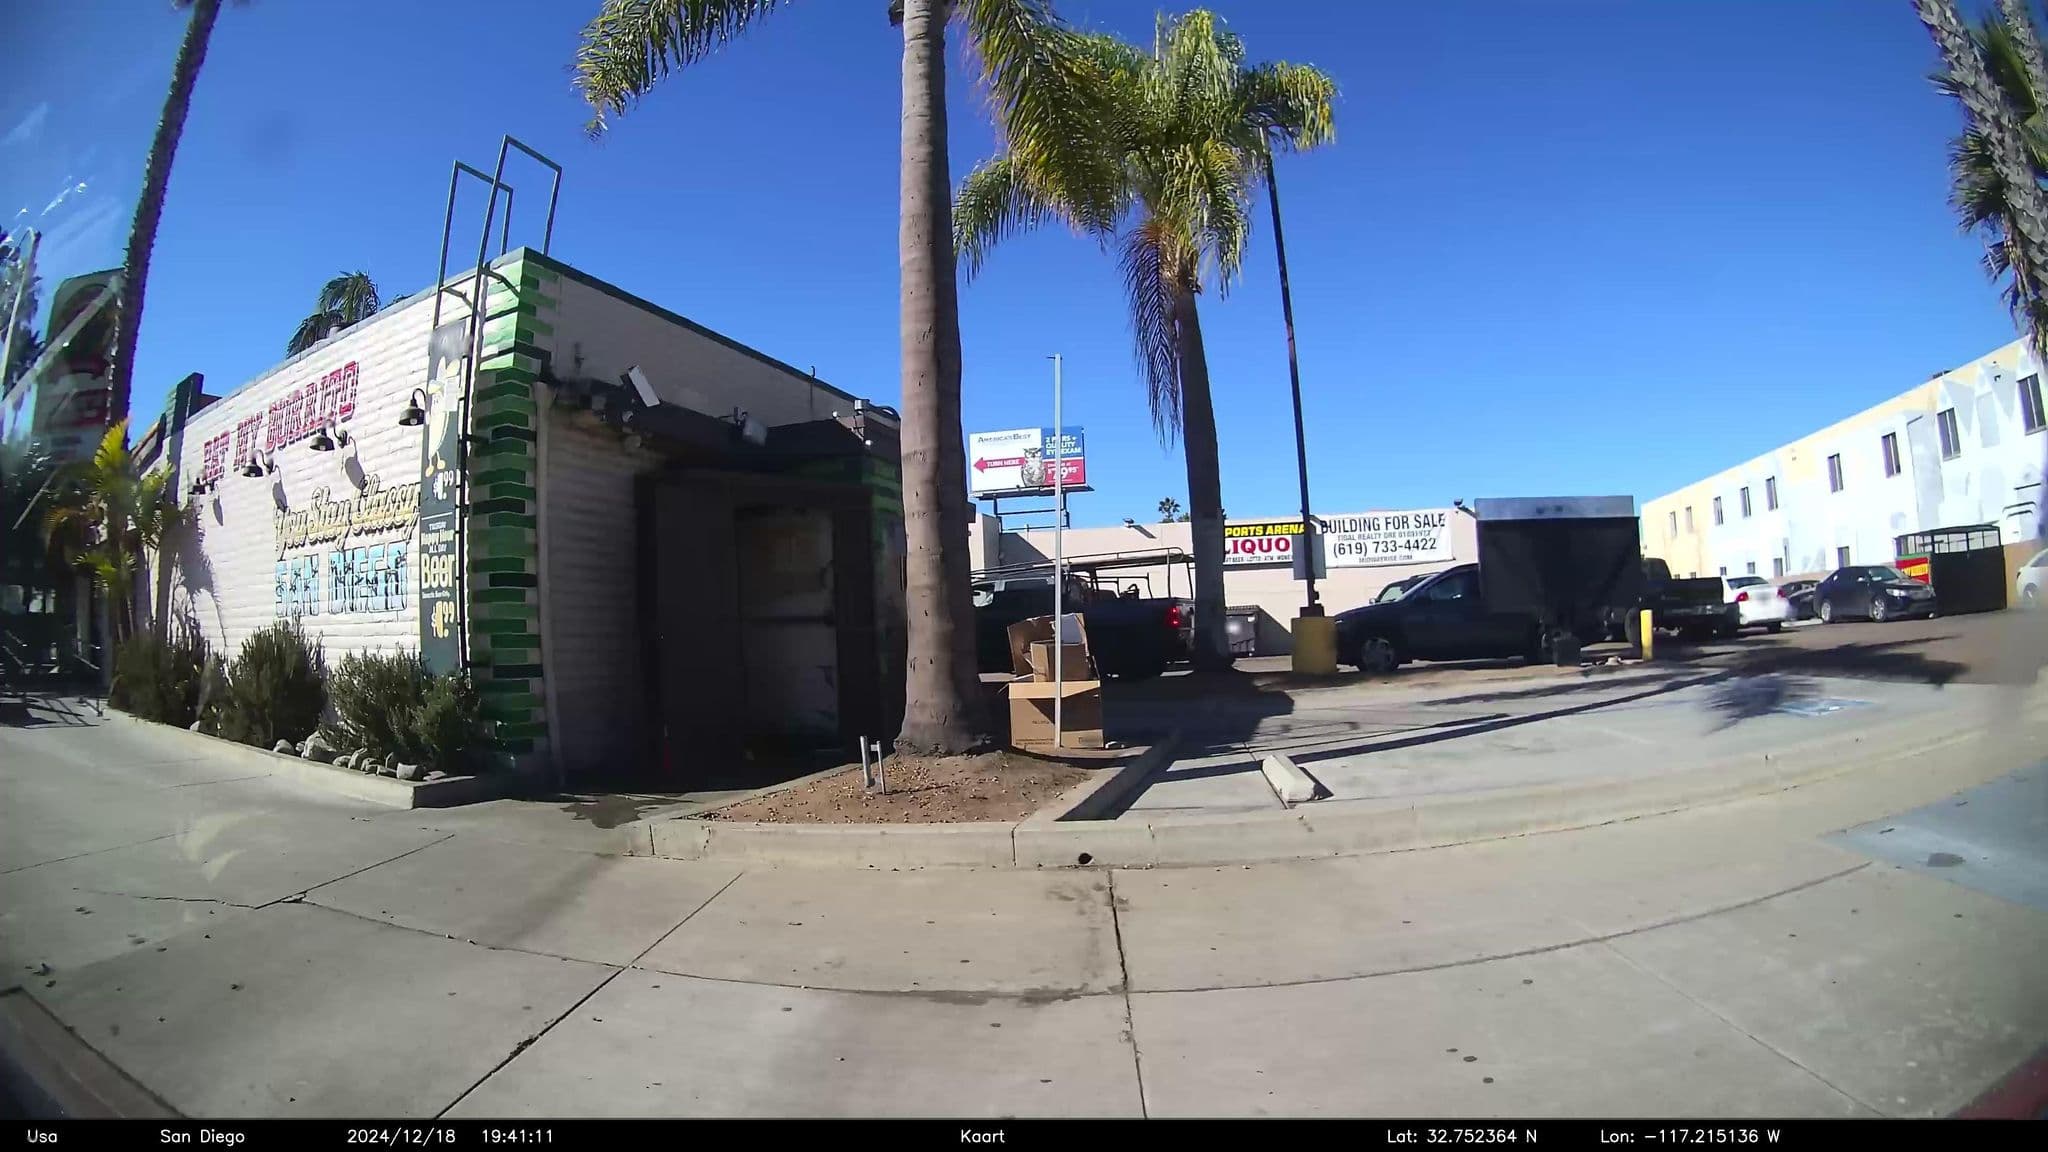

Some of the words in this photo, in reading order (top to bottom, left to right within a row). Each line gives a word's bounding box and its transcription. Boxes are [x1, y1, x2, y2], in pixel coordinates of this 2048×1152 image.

[234, 411, 263, 472] MY
[265, 360, 359, 455] BURRITO
[1225, 525, 1264, 537] PORTS
[1321, 517, 1381, 534] BUILDING
[1385, 515, 1410, 530] FOR
[1414, 513, 1446, 528] SALE
[1224, 536, 1291, 555] IQUO
[1333, 541, 1368, 558] (619)
[1371, 537, 1437, 554] 733-4422
[275, 553, 319, 618] SAN
[328, 541, 408, 614] DIEGO
[420, 553, 455, 589] Beer
